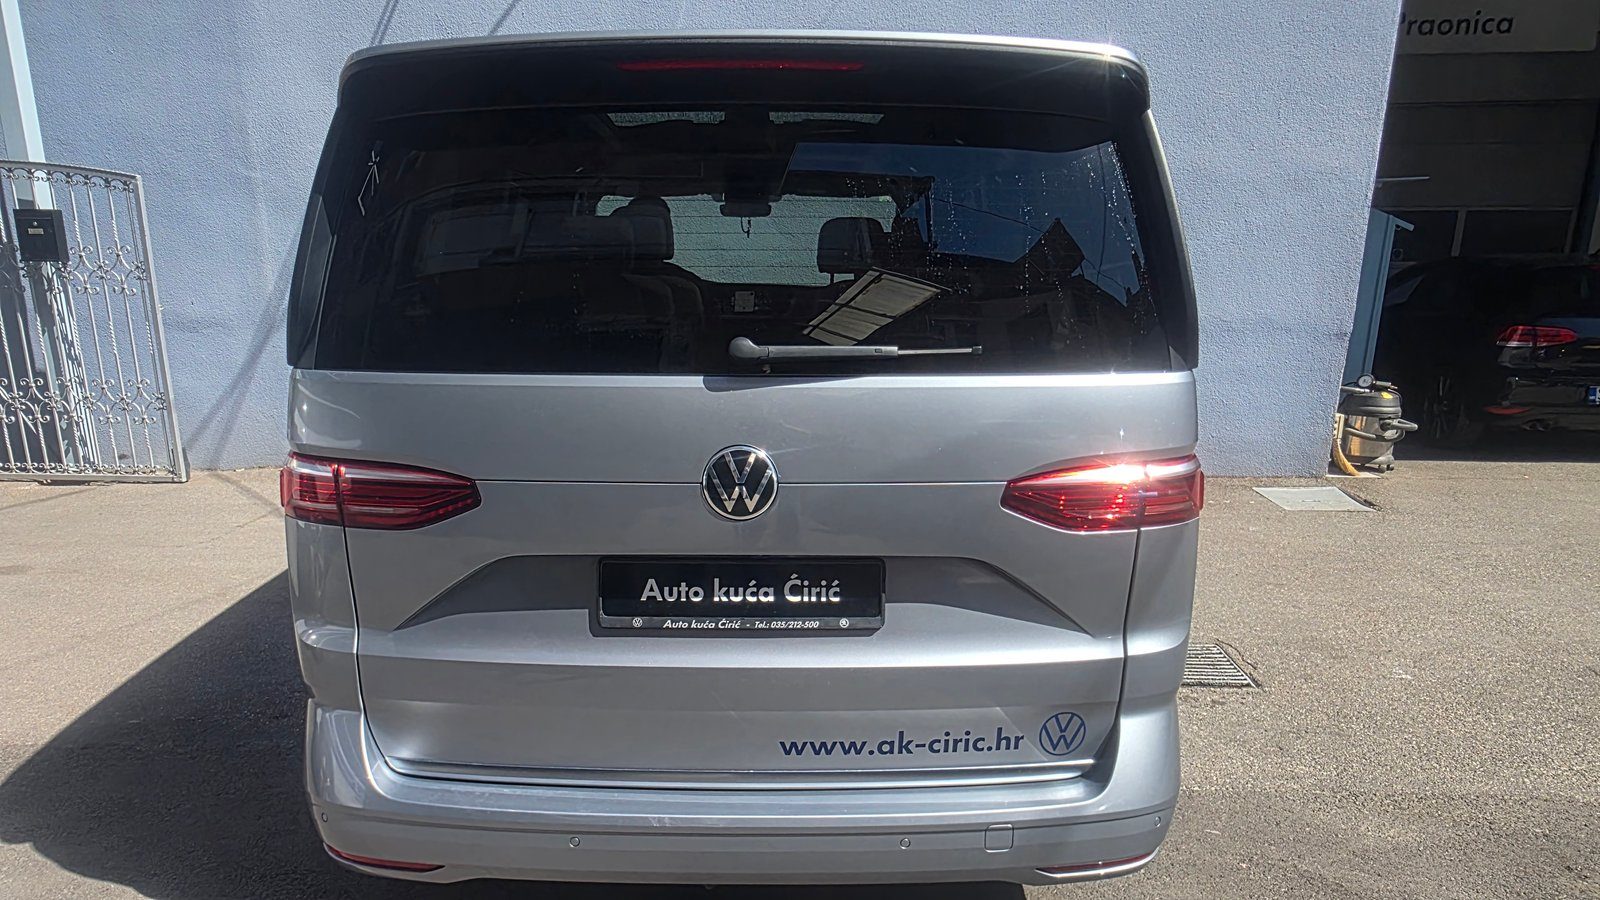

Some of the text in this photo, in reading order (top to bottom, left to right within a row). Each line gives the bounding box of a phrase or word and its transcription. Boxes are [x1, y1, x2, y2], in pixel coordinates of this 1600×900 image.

[706, 449, 774, 514] VW
[640, 573, 841, 602] Auto kuća Ćirić
[662, 619, 689, 629] Auto
[690, 619, 716, 629] kuća
[718, 618, 741, 629] Ćirić
[770, 620, 820, 629] 035/212-500
[779, 726, 1025, 756] www.ak-ciric.hr
[1042, 712, 1085, 752] VW
